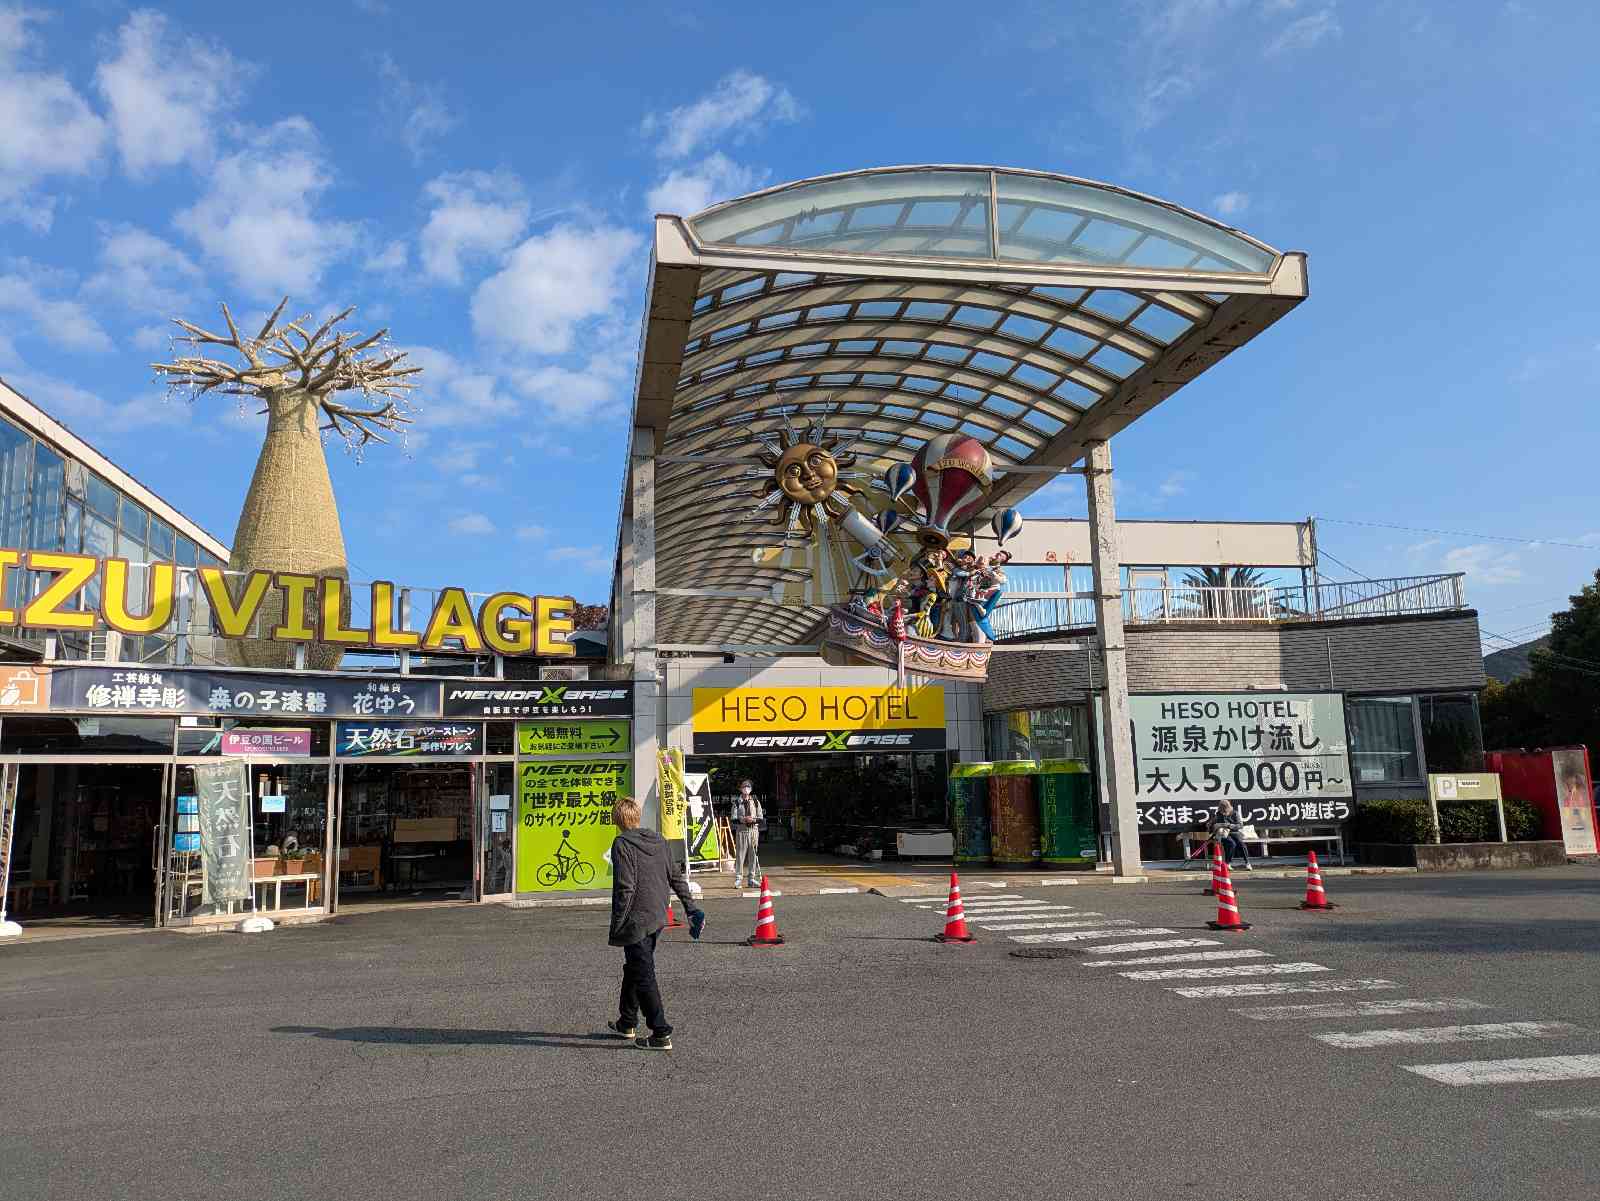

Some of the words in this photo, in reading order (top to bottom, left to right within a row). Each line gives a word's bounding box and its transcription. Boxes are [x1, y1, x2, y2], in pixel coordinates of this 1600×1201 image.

[197, 567, 577, 657] VILLAGE
[85, 685, 186, 709] 修禅寺彫
[208, 686, 327, 713] 森の子漆器
[352, 693, 415, 714] 花ゆう
[449, 690, 543, 700] MERIDA
[562, 689, 628, 700] BASE
[720, 695, 807, 723] HESO
[820, 695, 919, 722] HOTEL
[1161, 702, 1220, 719] HESO
[1228, 700, 1299, 718] HOTEL
[229, 734, 304, 745] 伊豆の国ビール
[345, 727, 415, 750] 天然石
[529, 727, 583, 740] 入場無料
[730, 736, 825, 748] MERIDA
[846, 734, 914, 745] BASE
[1151, 723, 1321, 753] 源泉かけ流し
[522, 763, 627, 776] MERIDA
[1238, 801, 1350, 822] しっかり遊ぼう
